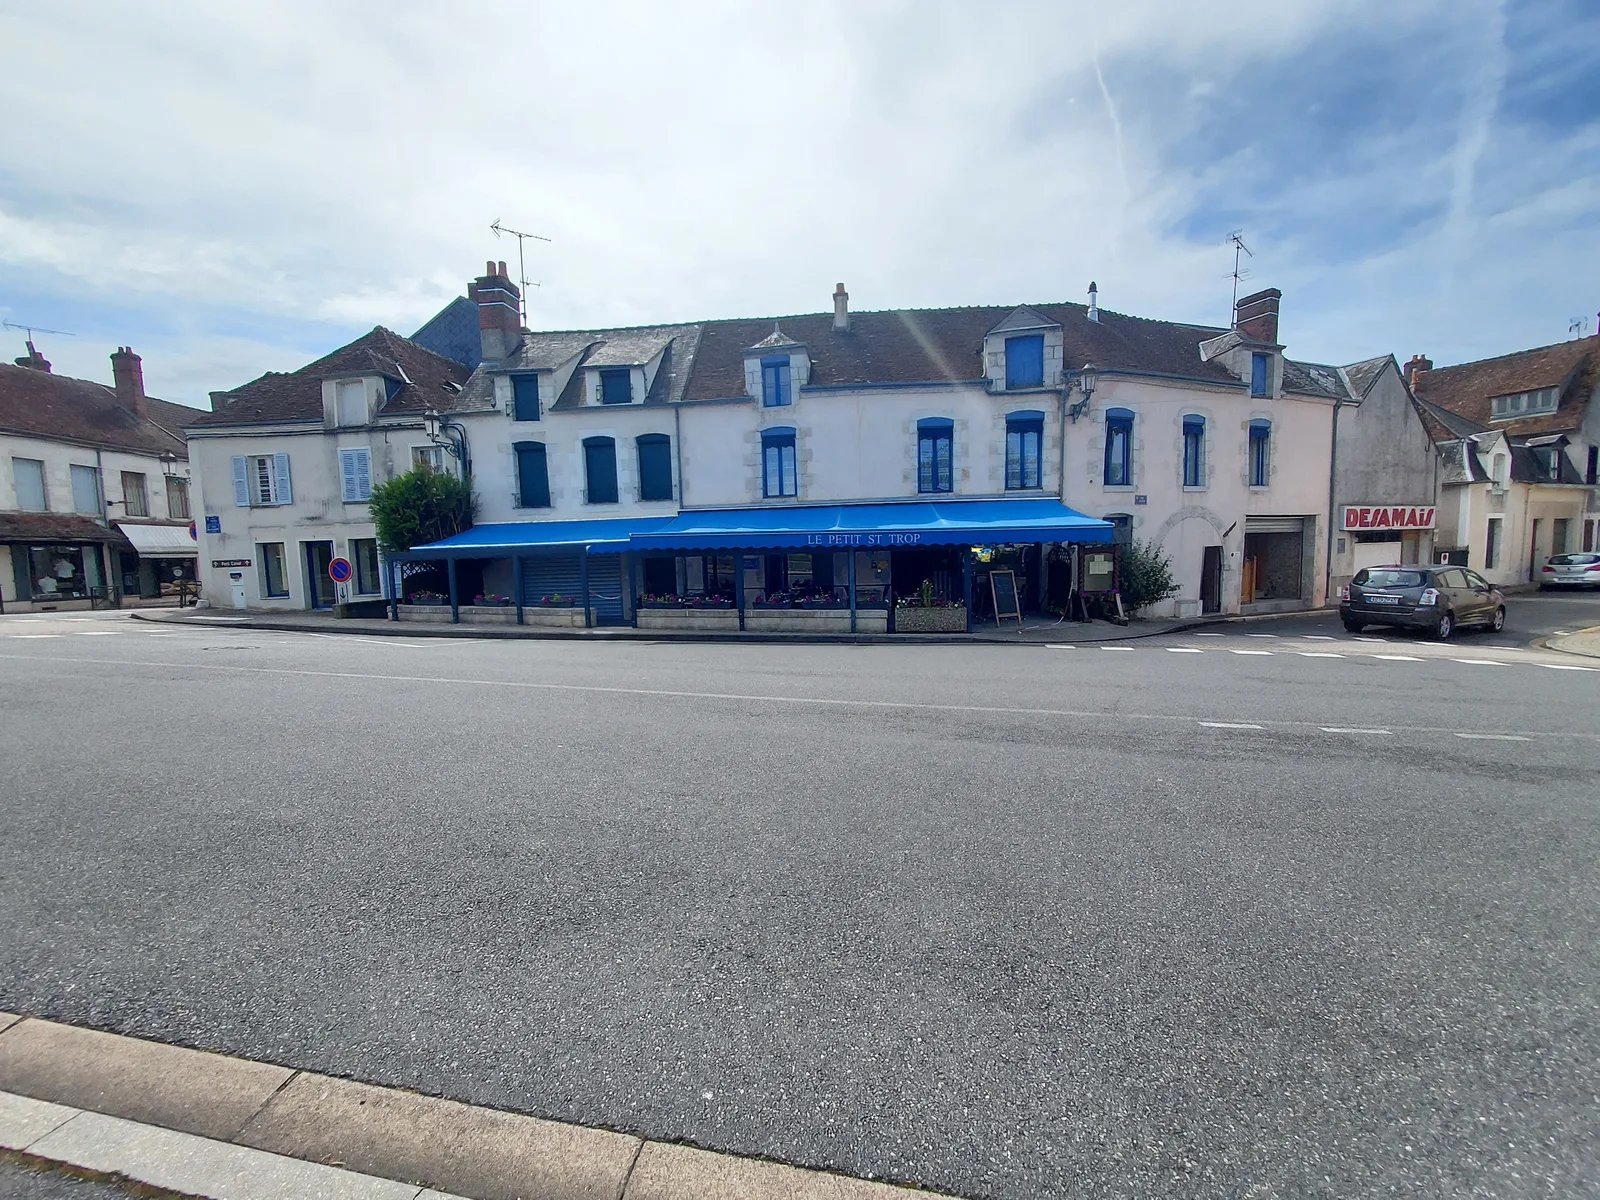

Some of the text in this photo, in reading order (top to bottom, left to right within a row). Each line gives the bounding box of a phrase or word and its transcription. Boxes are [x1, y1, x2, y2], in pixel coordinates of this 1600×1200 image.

[807, 533, 920, 545] LE PETIT ST TROP
